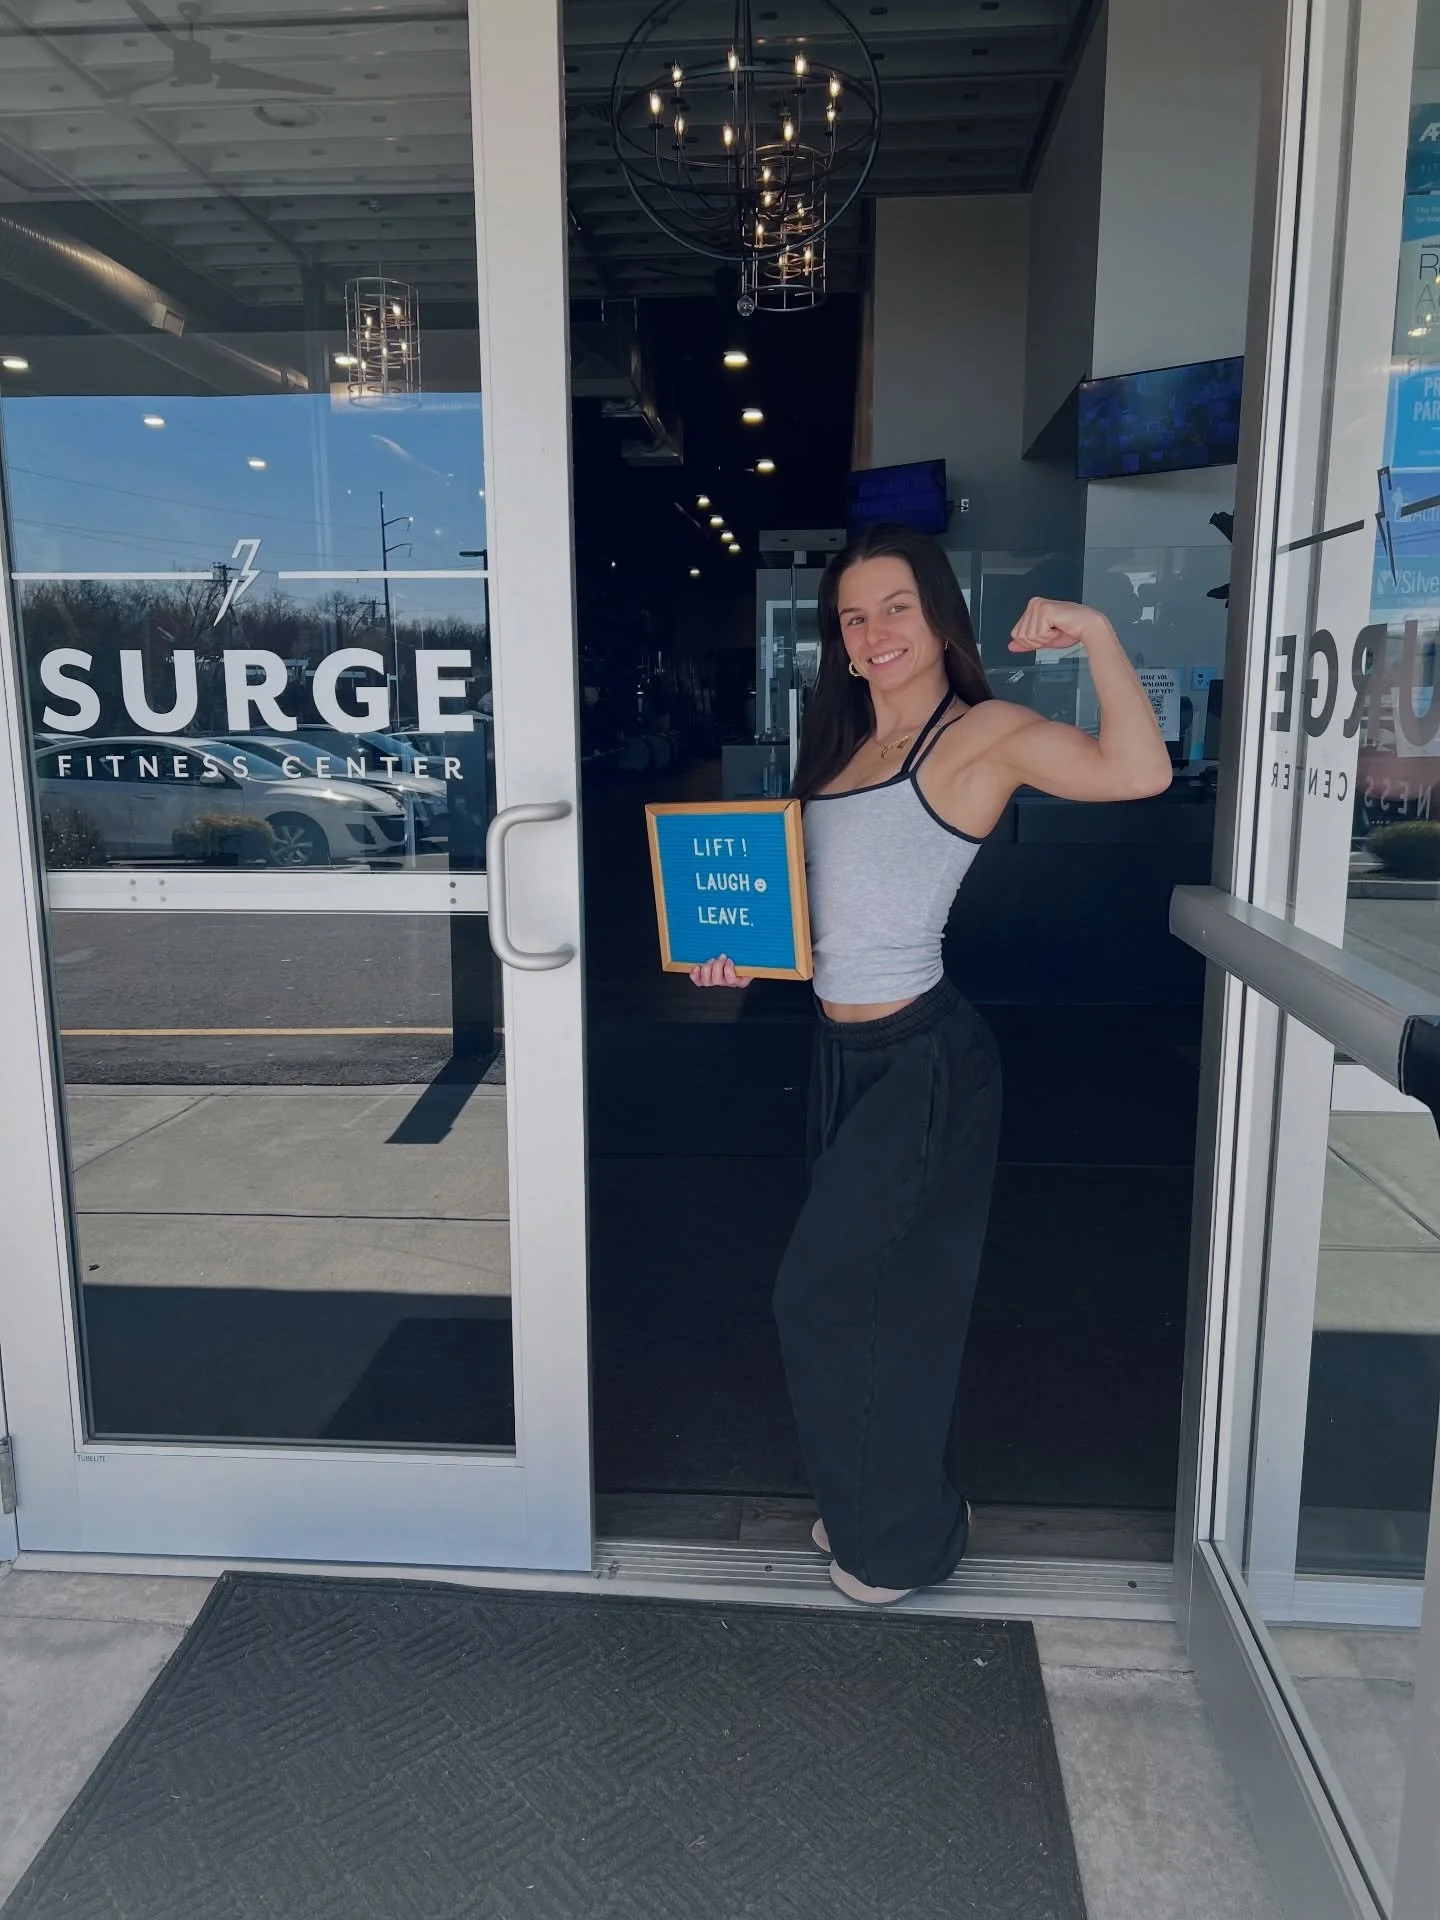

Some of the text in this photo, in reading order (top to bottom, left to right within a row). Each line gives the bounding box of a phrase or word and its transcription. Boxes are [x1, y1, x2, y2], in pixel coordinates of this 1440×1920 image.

[39, 647, 475, 733] SURGE
[58, 754, 464, 780] FITNESS CENTER
[695, 872, 750, 892] LAUGH
